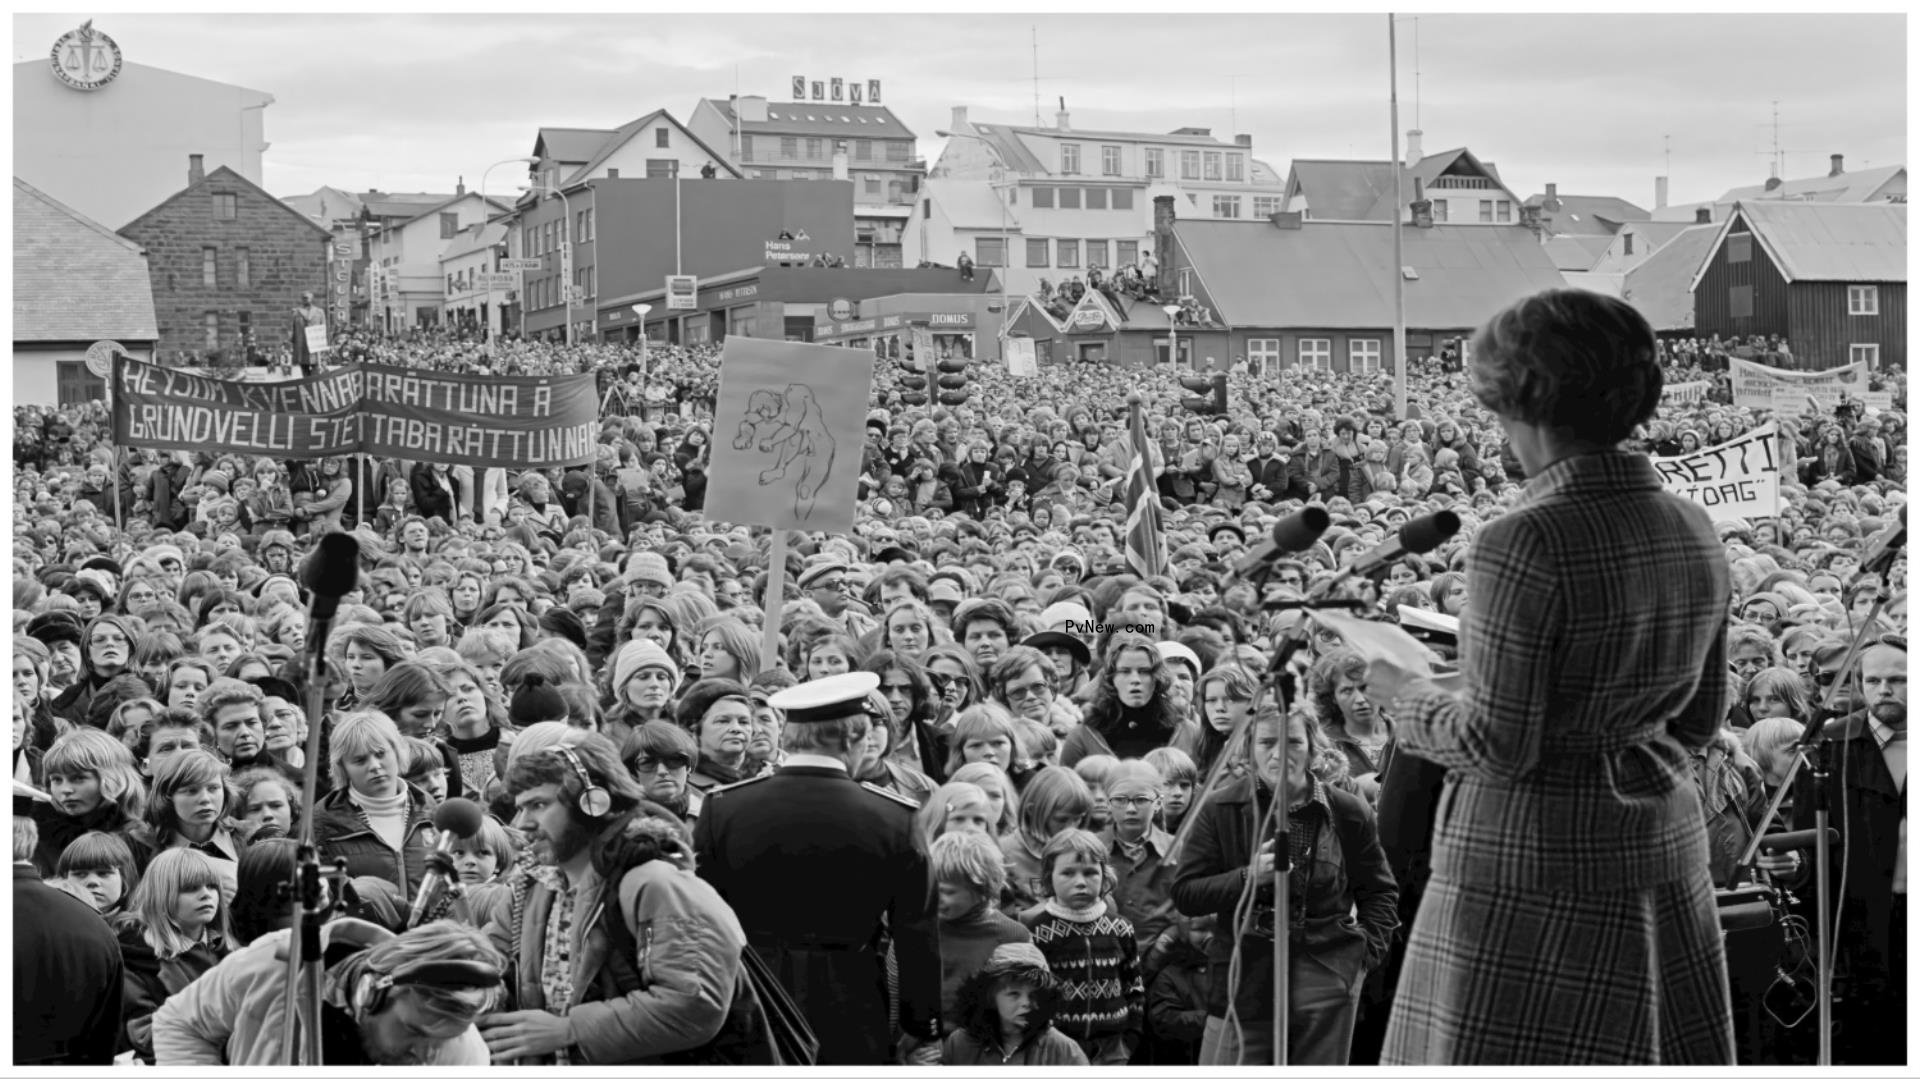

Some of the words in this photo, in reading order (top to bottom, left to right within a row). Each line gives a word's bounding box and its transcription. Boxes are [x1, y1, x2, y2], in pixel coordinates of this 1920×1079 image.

[765, 241, 791, 251] Hans
[335, 243, 352, 321] STELLA
[932, 313, 968, 324] DOMUS
[1655, 432, 1777, 484] RETTI
